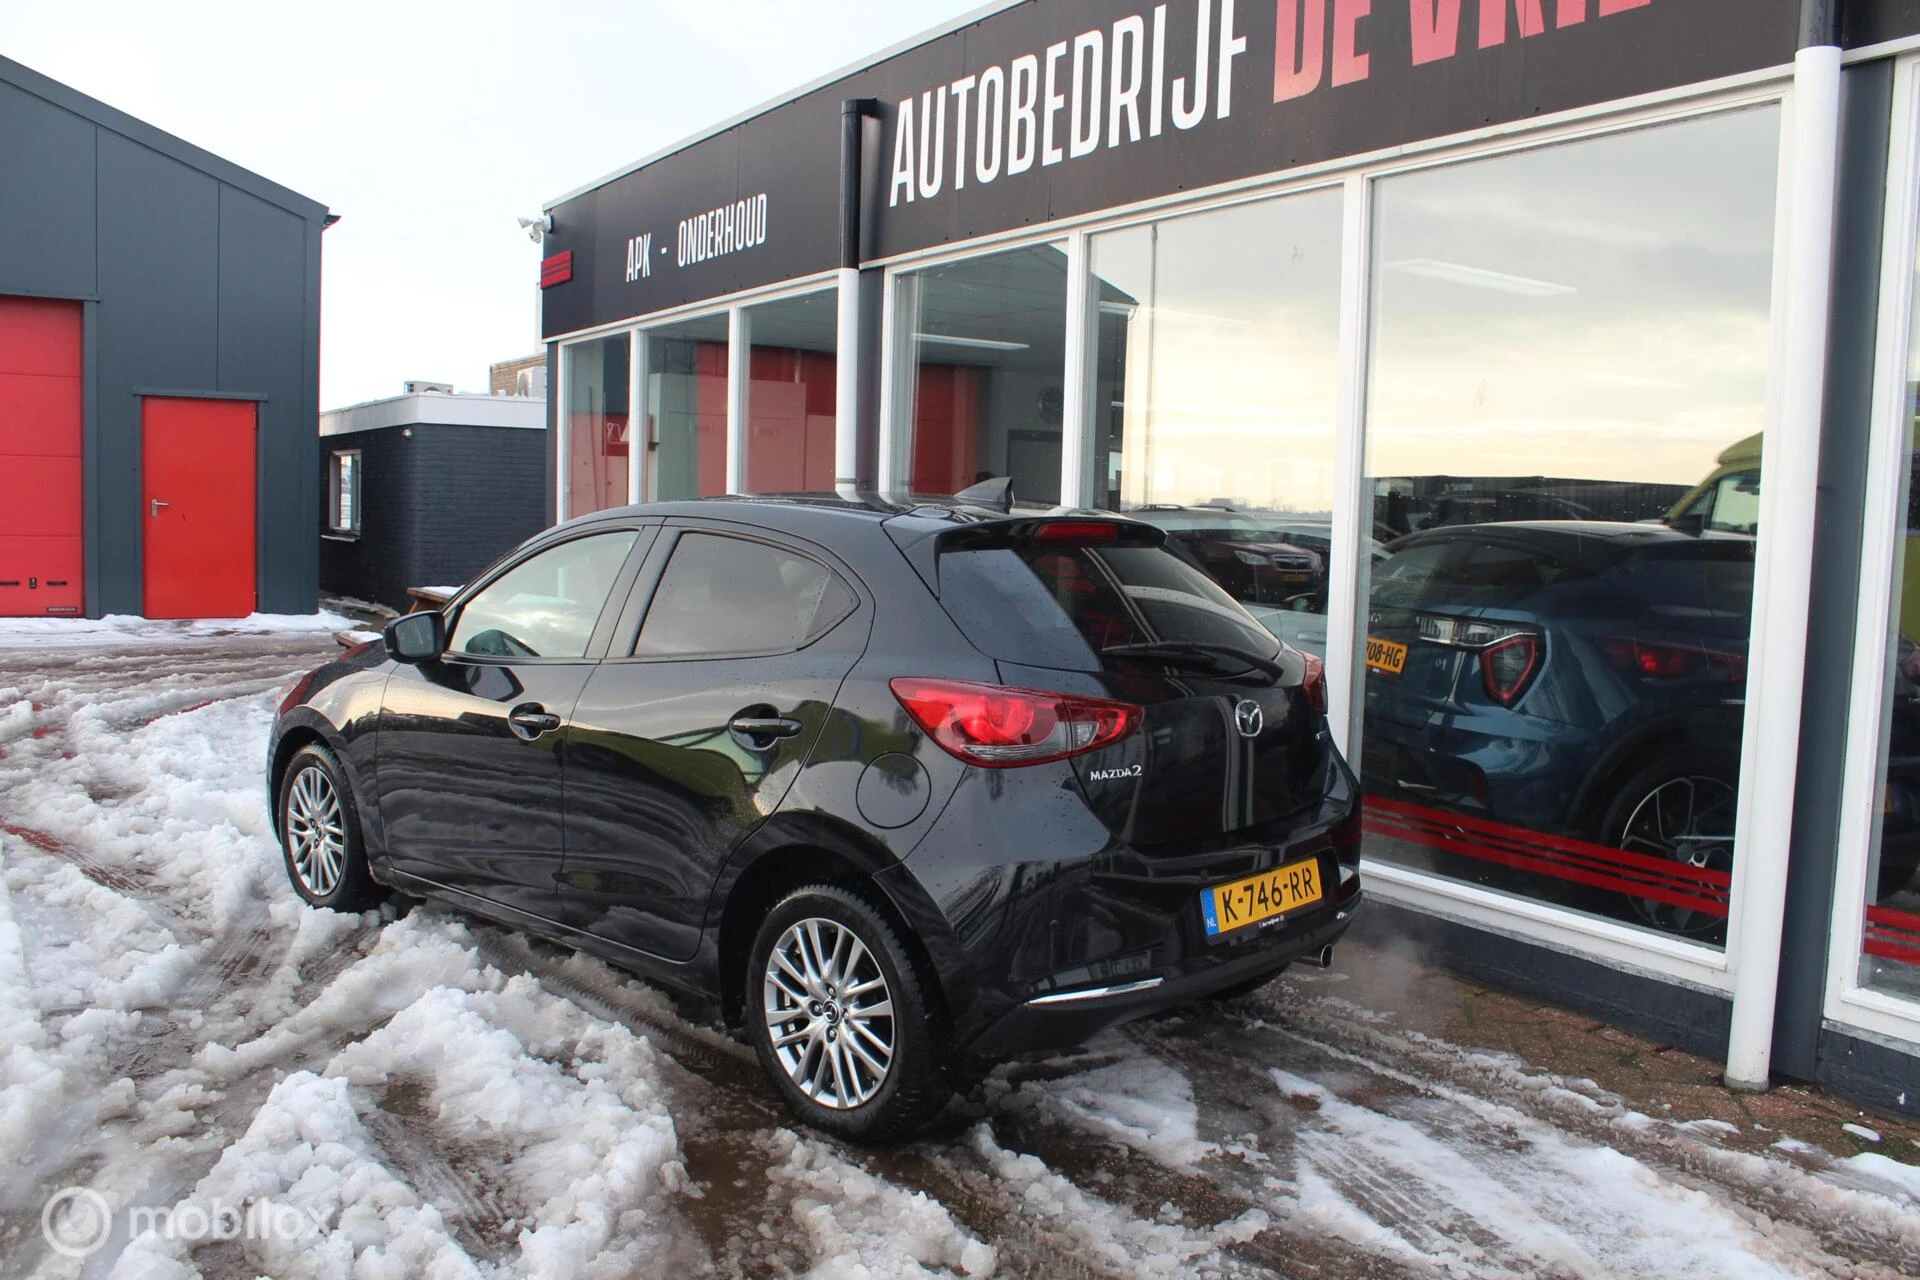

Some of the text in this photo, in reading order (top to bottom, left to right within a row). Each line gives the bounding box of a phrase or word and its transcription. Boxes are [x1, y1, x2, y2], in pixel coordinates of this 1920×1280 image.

[890, 0, 1246, 208] AUTOBEDRIJF
[1274, 0, 1371, 103] DE
[626, 233, 651, 282] APK
[677, 193, 767, 267] ONDERHOUD
[1206, 917, 1217, 928] NL
[1222, 867, 1315, 923] K-746-RR
